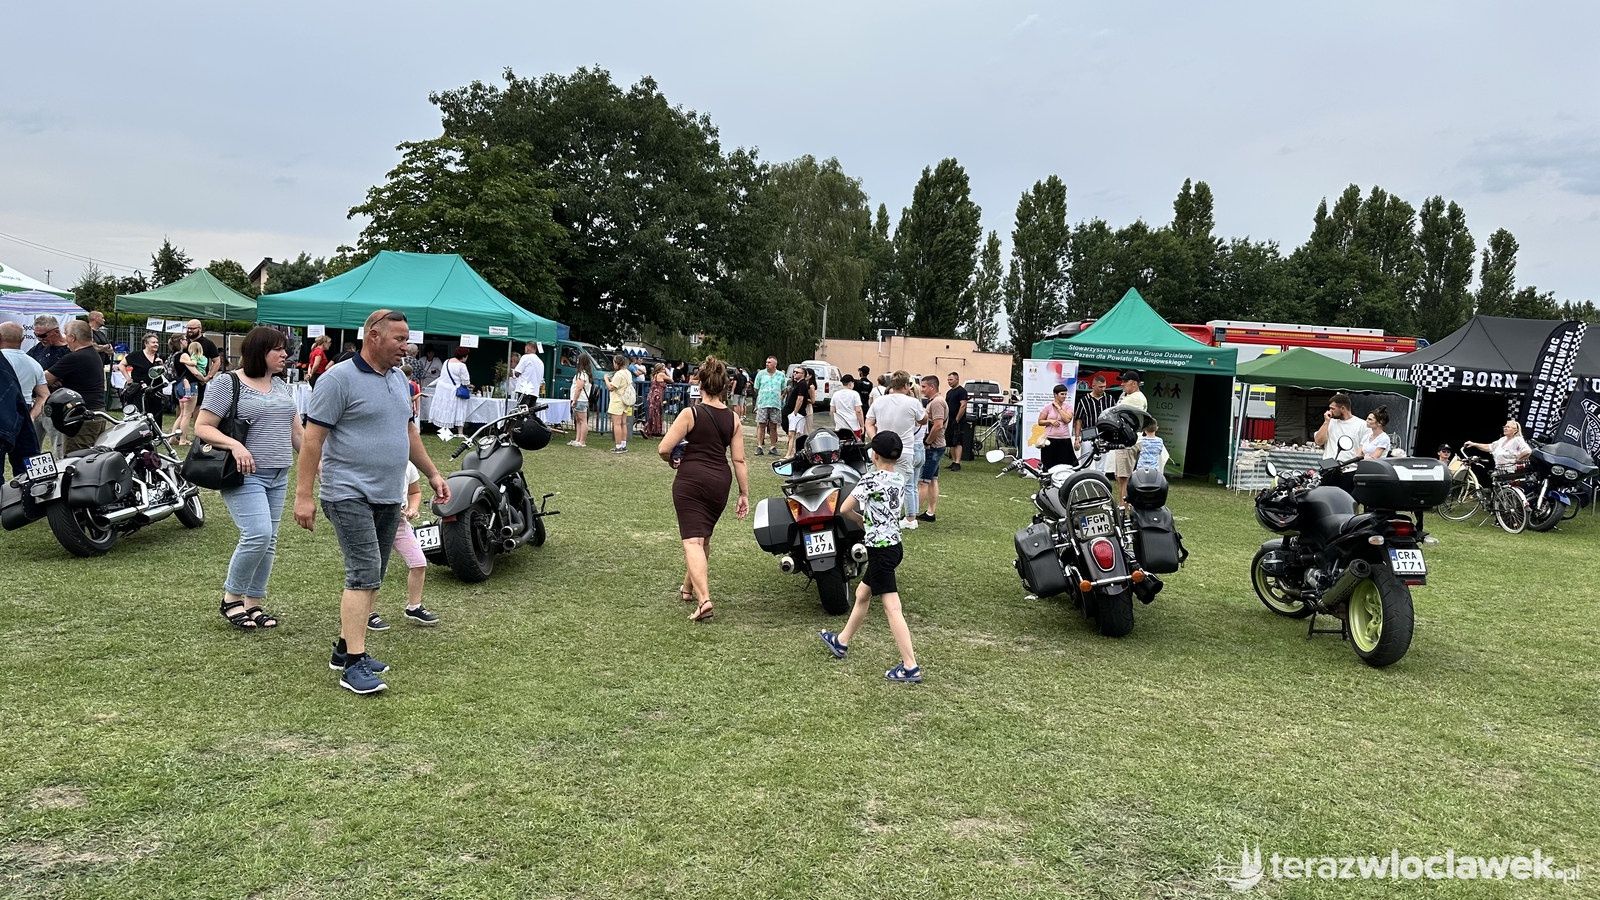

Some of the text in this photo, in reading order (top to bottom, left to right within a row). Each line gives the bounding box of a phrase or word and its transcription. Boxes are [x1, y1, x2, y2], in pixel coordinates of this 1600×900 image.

[1068, 344, 1116, 354] Stowarzyszenie
[1117, 348, 1142, 356] Lokalna
[1143, 350, 1163, 358] Grupa
[1073, 351, 1095, 359] Razem
[1107, 354, 1132, 362] Powiatu
[1550, 330, 1574, 382] KUJAWSKI
[1461, 370, 1518, 388] BORN
[1525, 337, 1560, 428] BORN TO RIDE MC
[1156, 402, 1174, 410] LGD
[31, 456, 48, 467] CTR
[29, 464, 54, 477] TX68
[1087, 514, 1106, 525] FGW
[420, 529, 432, 538] CT
[813, 534, 825, 543] TK
[808, 543, 834, 554] 367A
[1397, 551, 1417, 560] CRA
[1396, 561, 1422, 570] JT71
